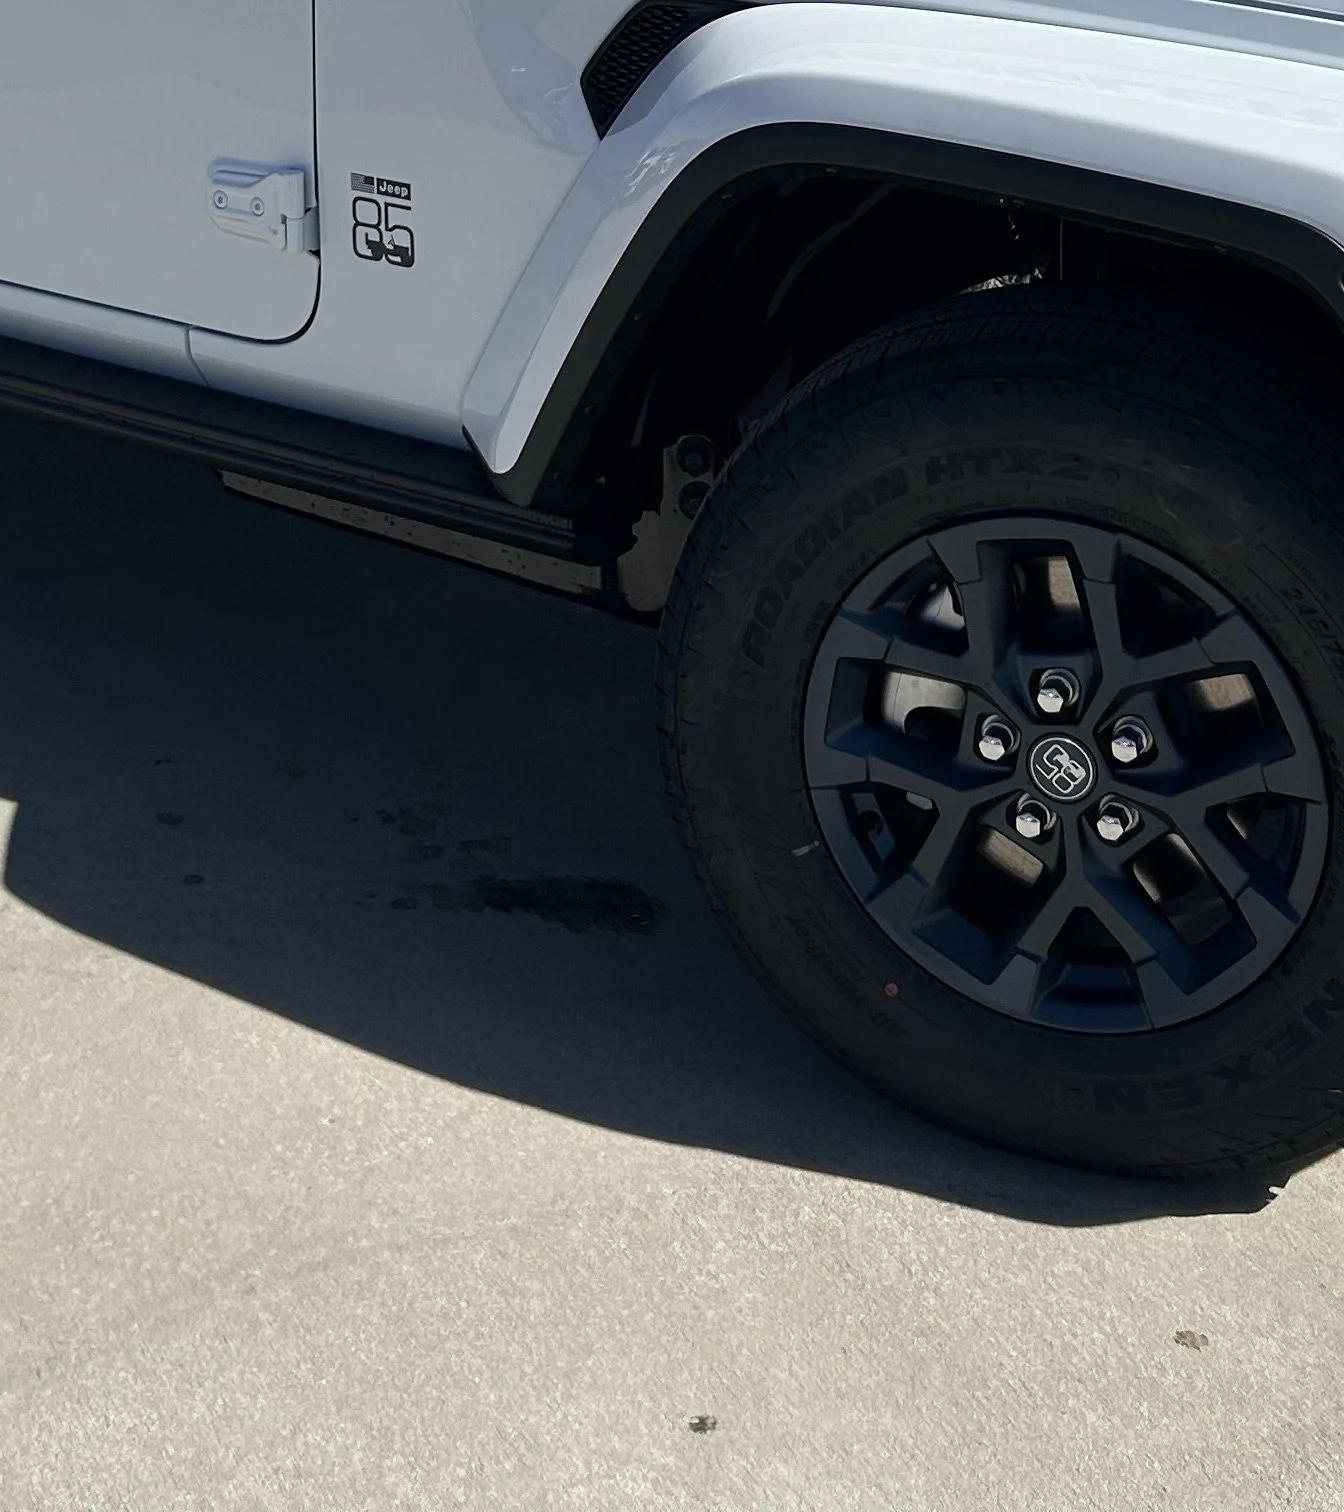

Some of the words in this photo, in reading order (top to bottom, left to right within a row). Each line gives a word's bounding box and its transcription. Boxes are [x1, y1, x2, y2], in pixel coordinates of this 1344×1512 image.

[379, 180, 409, 197] Jeep
[352, 196, 415, 268] 85
[924, 446, 1095, 486] HTX2
